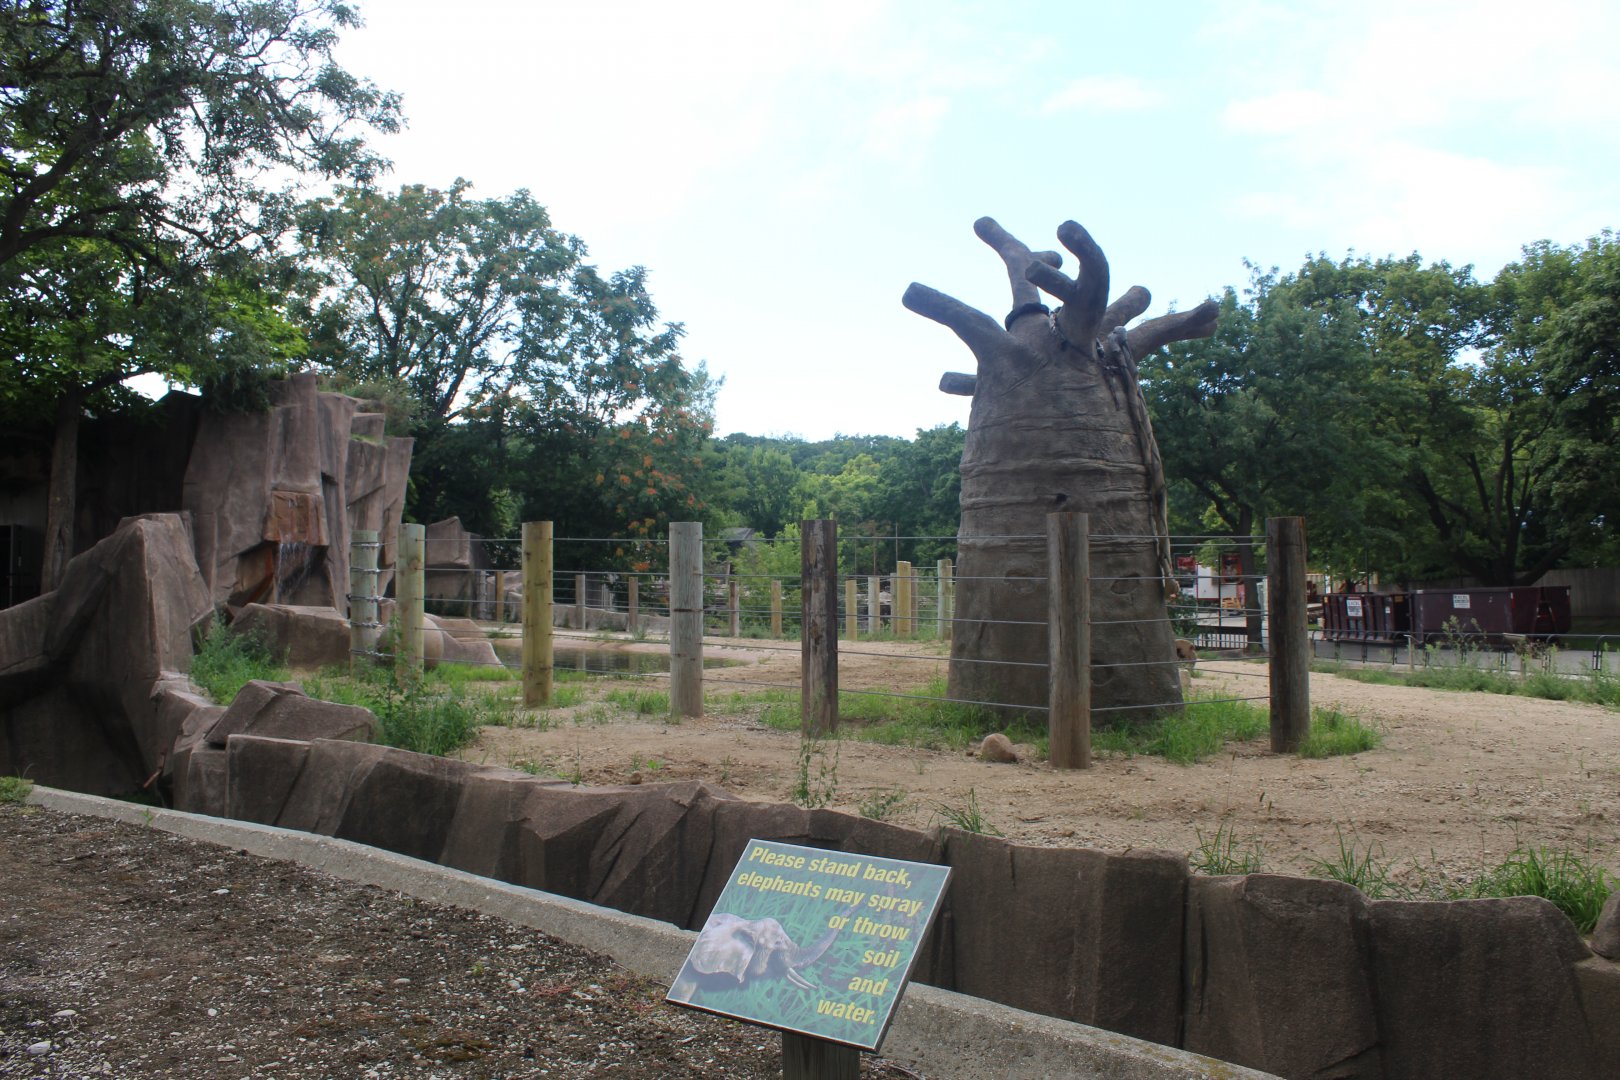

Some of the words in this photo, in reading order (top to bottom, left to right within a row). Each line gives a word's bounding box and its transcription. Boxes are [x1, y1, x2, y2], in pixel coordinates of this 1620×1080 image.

[749, 846, 805, 869] Please
[808, 858, 861, 878] stand
[863, 864, 912, 888] back,
[737, 872, 821, 897] elephants
[825, 888, 865, 908] may
[868, 895, 922, 917] spray
[828, 916, 850, 930] or
[853, 917, 910, 940] throw
[862, 950, 900, 968] soil
[848, 975, 888, 996] and
[816, 998, 876, 1024] water.
